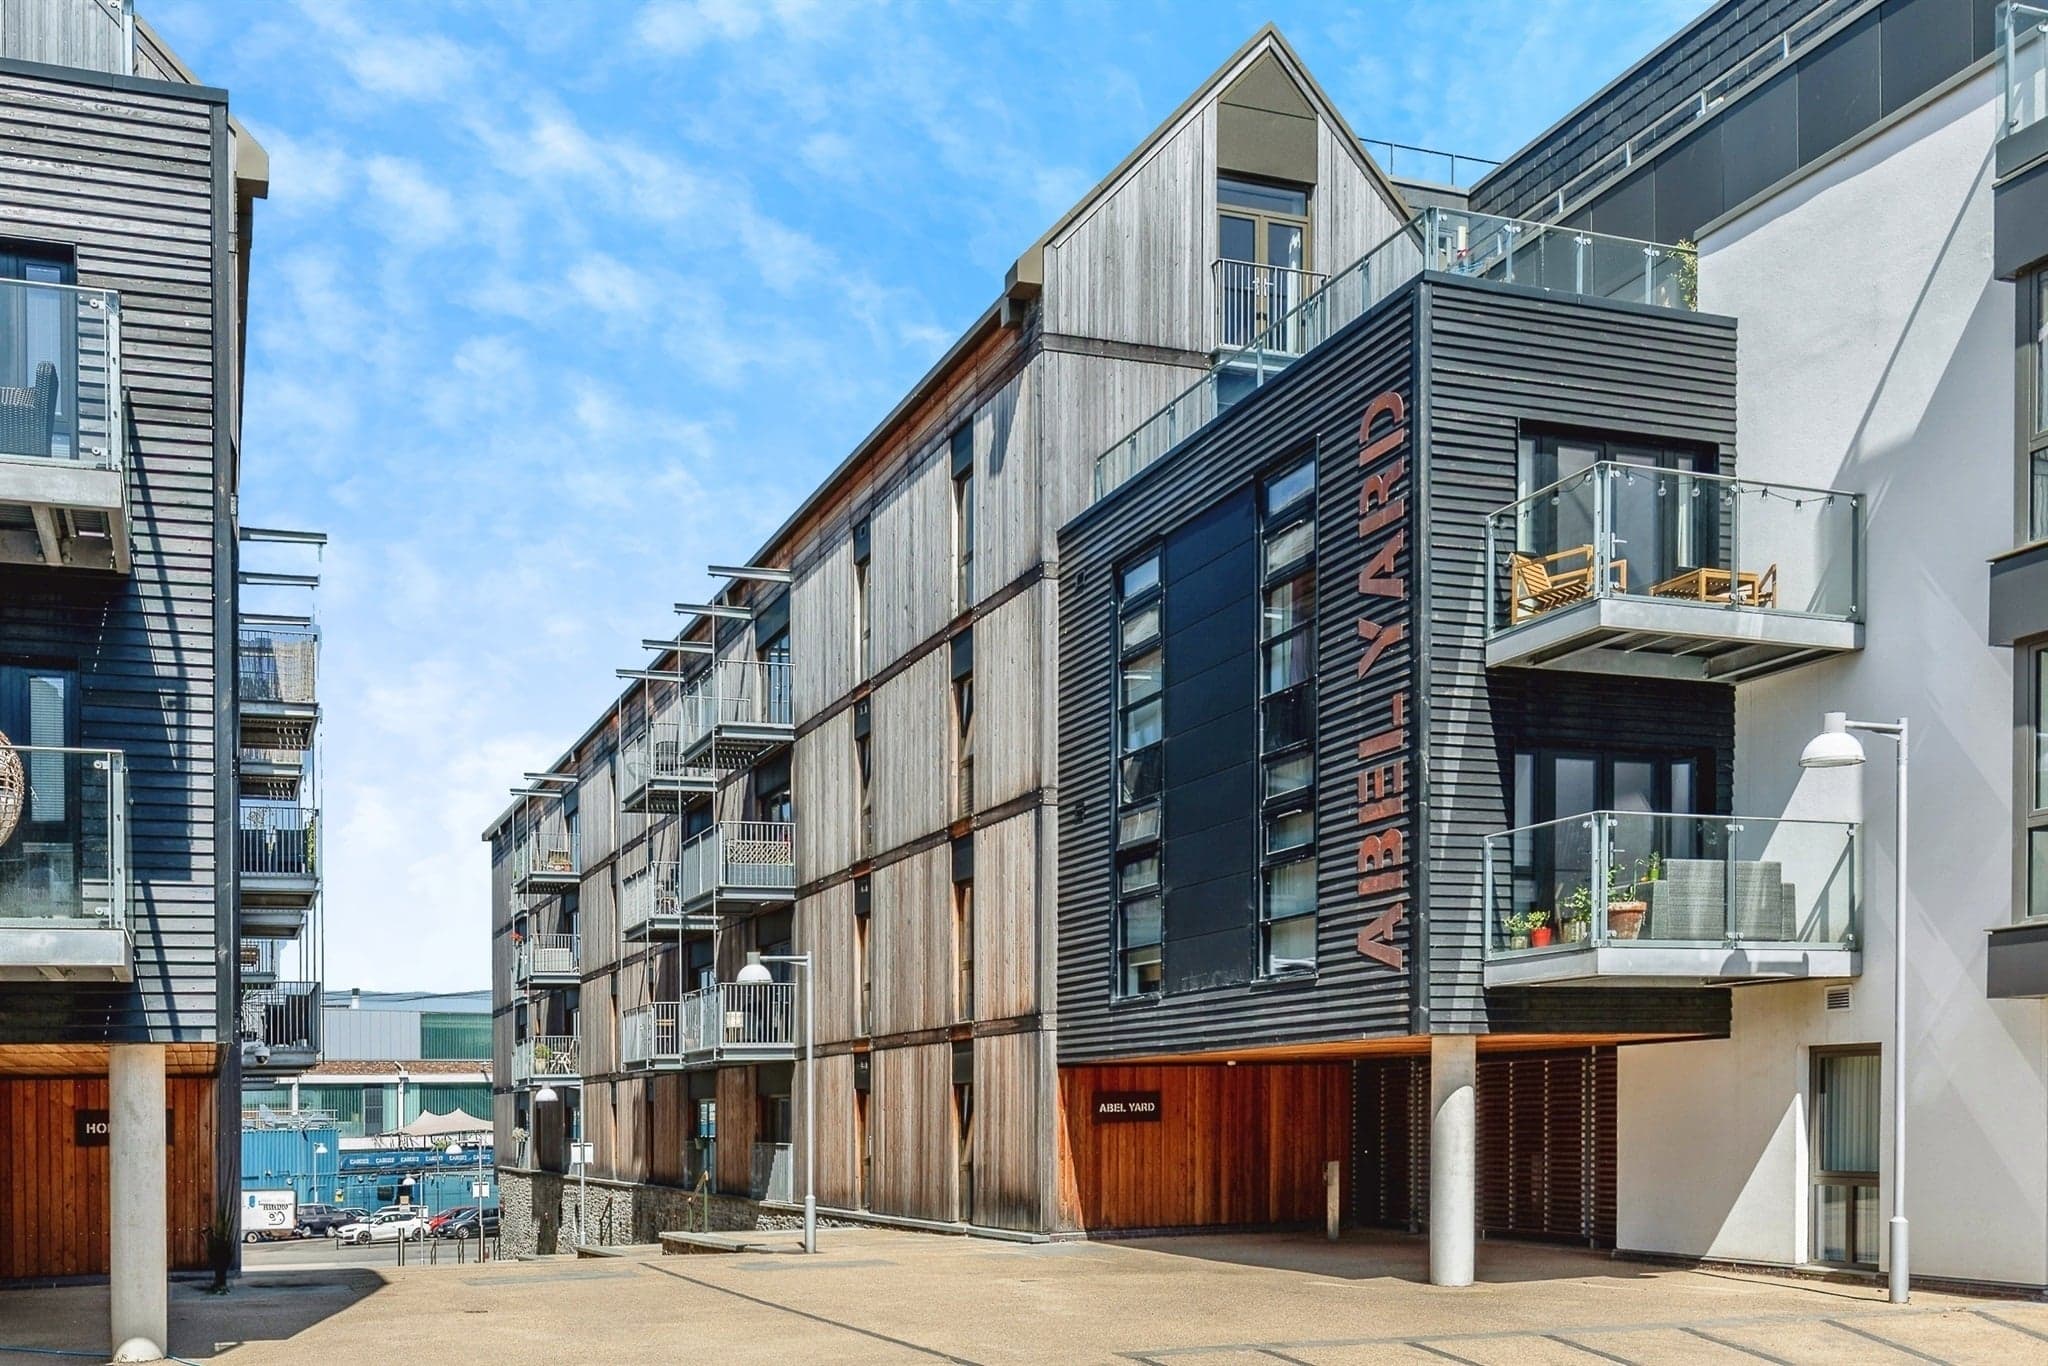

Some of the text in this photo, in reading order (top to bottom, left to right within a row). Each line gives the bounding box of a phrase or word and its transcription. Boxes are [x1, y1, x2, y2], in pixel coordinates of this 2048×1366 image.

[1358, 391, 1404, 970] ABEL YARD
[1099, 1102, 1155, 1113] ABEL YARD
